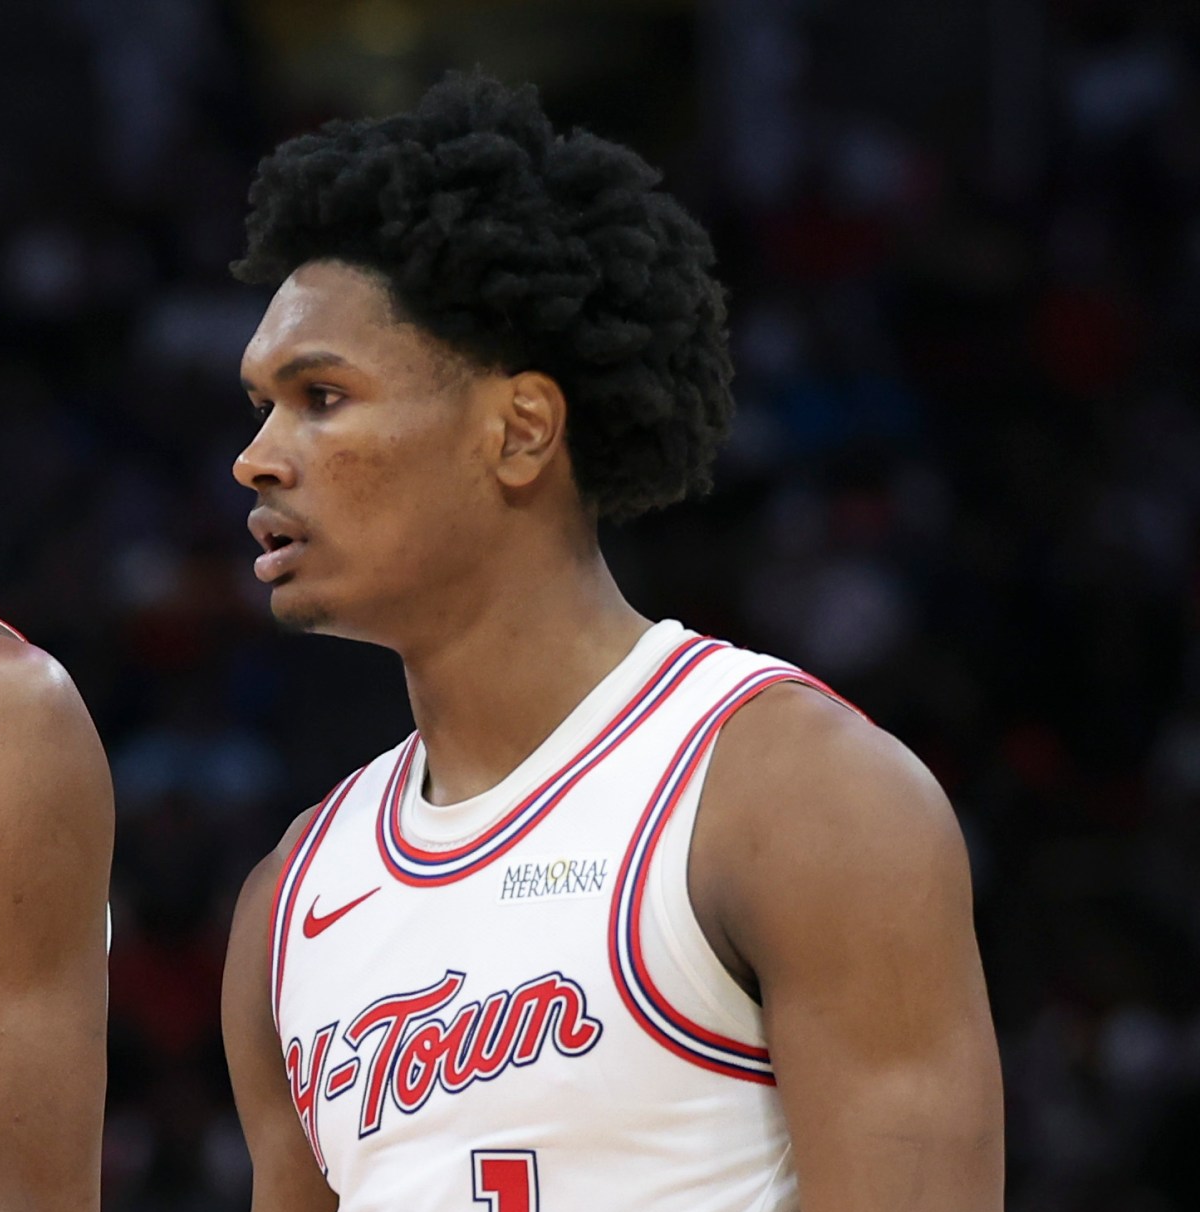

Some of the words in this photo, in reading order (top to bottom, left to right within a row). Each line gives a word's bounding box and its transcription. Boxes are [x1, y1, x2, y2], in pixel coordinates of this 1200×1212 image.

[503, 858, 608, 883] MEMORIAL
[500, 874, 605, 900] HERMANN
[284, 968, 604, 1179] H-Town
